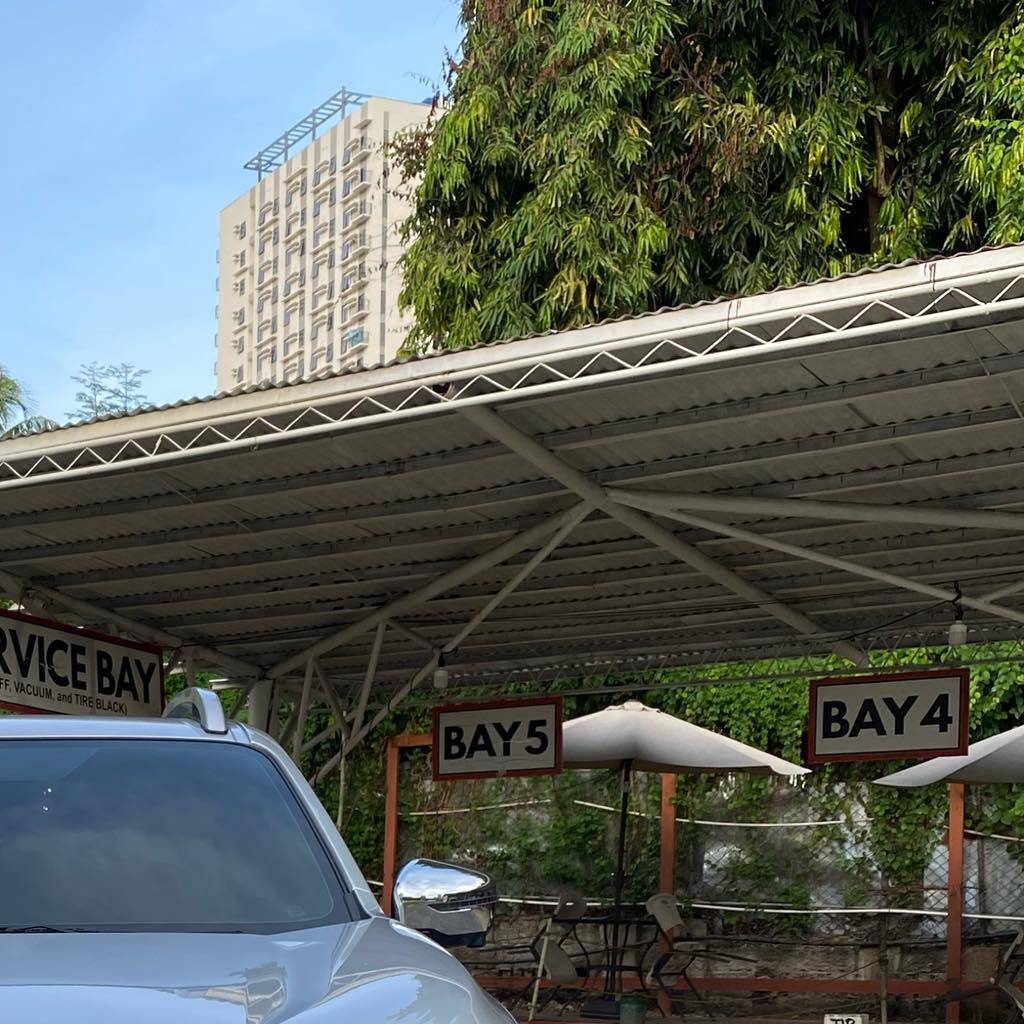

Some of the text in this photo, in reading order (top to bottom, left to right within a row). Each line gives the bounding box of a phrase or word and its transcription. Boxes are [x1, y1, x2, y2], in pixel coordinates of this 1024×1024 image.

[96, 650, 156, 704] BAY
[56, 692, 73, 705] and
[74, 693, 95, 708] TIRE
[95, 698, 128, 716] BLACK)
[822, 693, 954, 739] BAY 4
[443, 719, 550, 760] BAY 5
